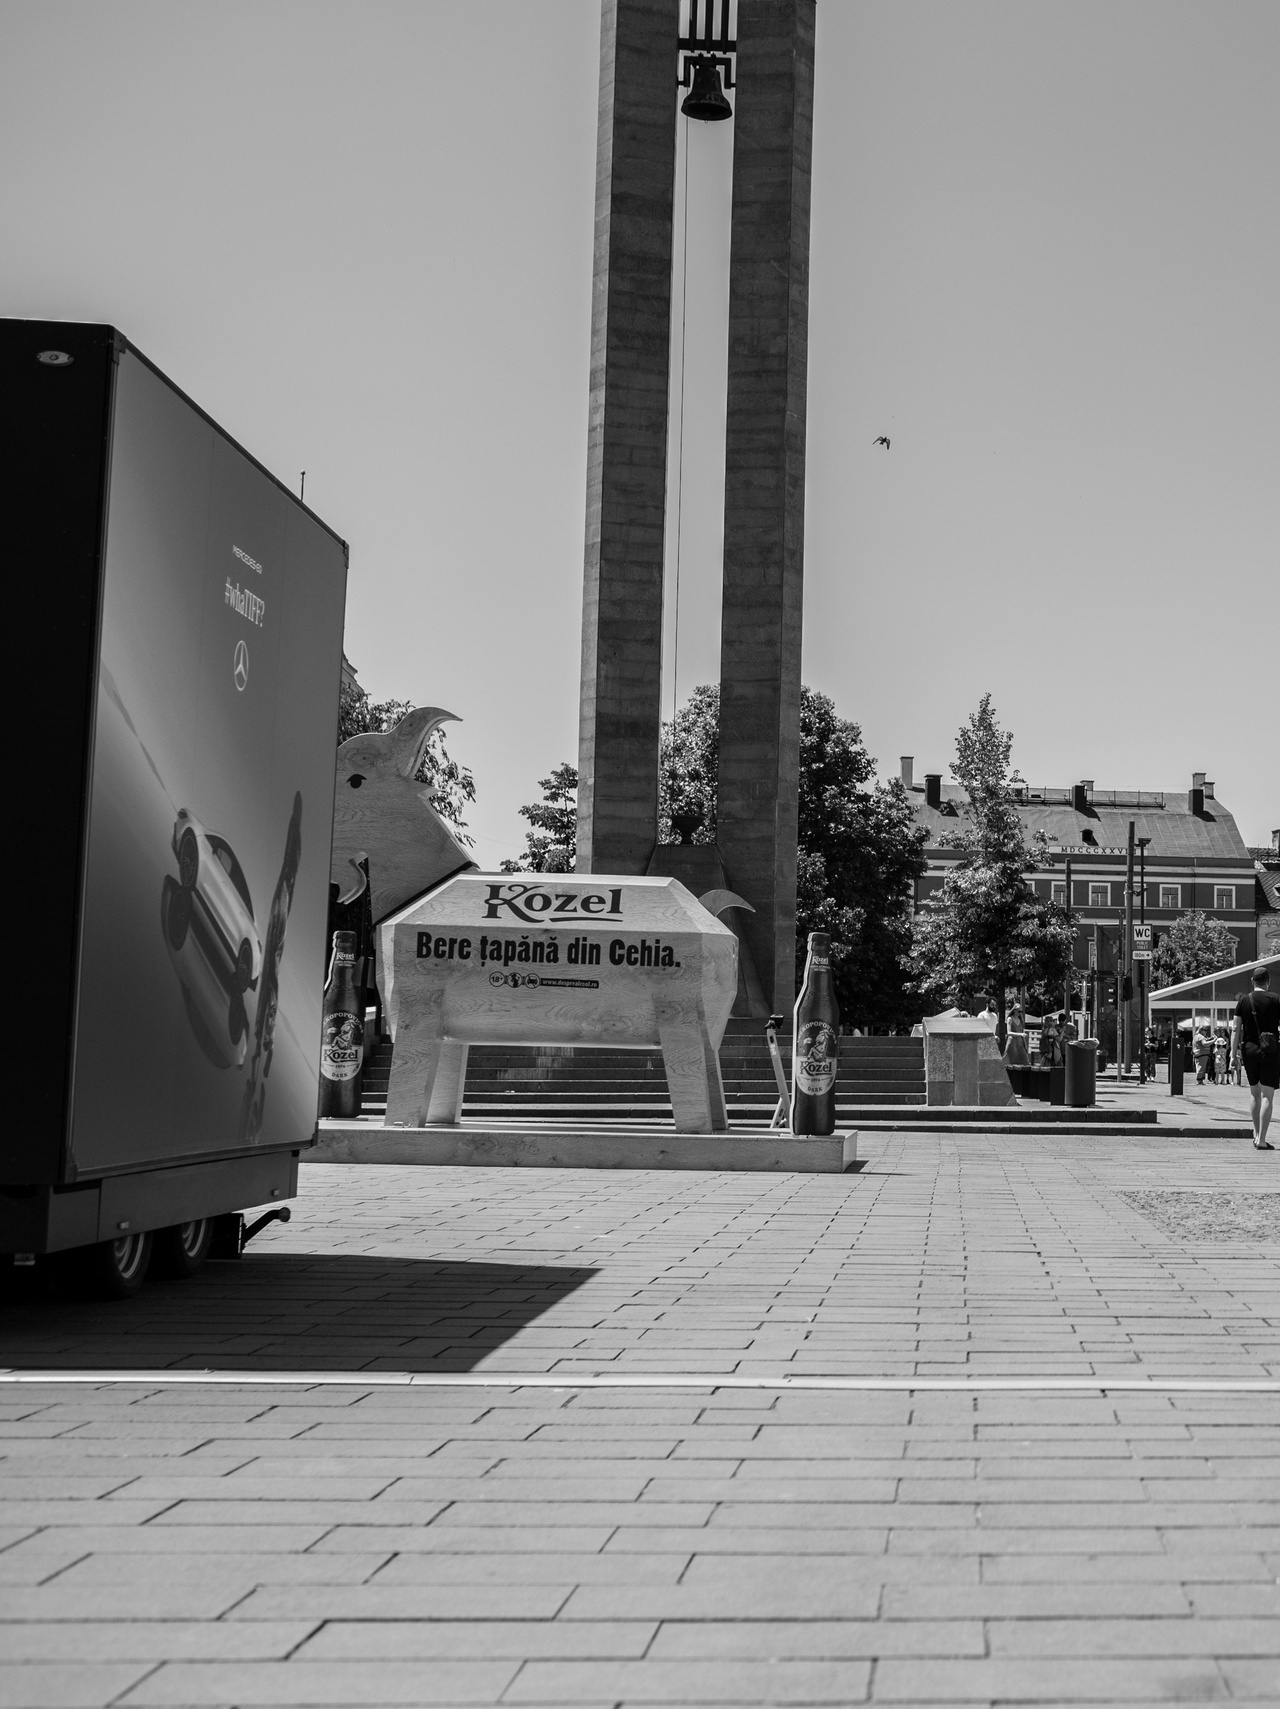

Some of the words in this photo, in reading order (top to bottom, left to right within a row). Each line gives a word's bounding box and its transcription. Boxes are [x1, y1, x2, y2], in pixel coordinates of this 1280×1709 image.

[1061, 846, 1136, 855] MDCCCXXVII
[481, 884, 624, 923] Kozel
[1135, 928, 1150, 938] WC
[416, 931, 472, 960] Bere
[479, 935, 560, 967] țapănă
[567, 936, 602, 966] din
[608, 938, 681, 968] Cehia.
[323, 1048, 358, 1063] Kozel
[799, 1060, 833, 1077] Kozel
